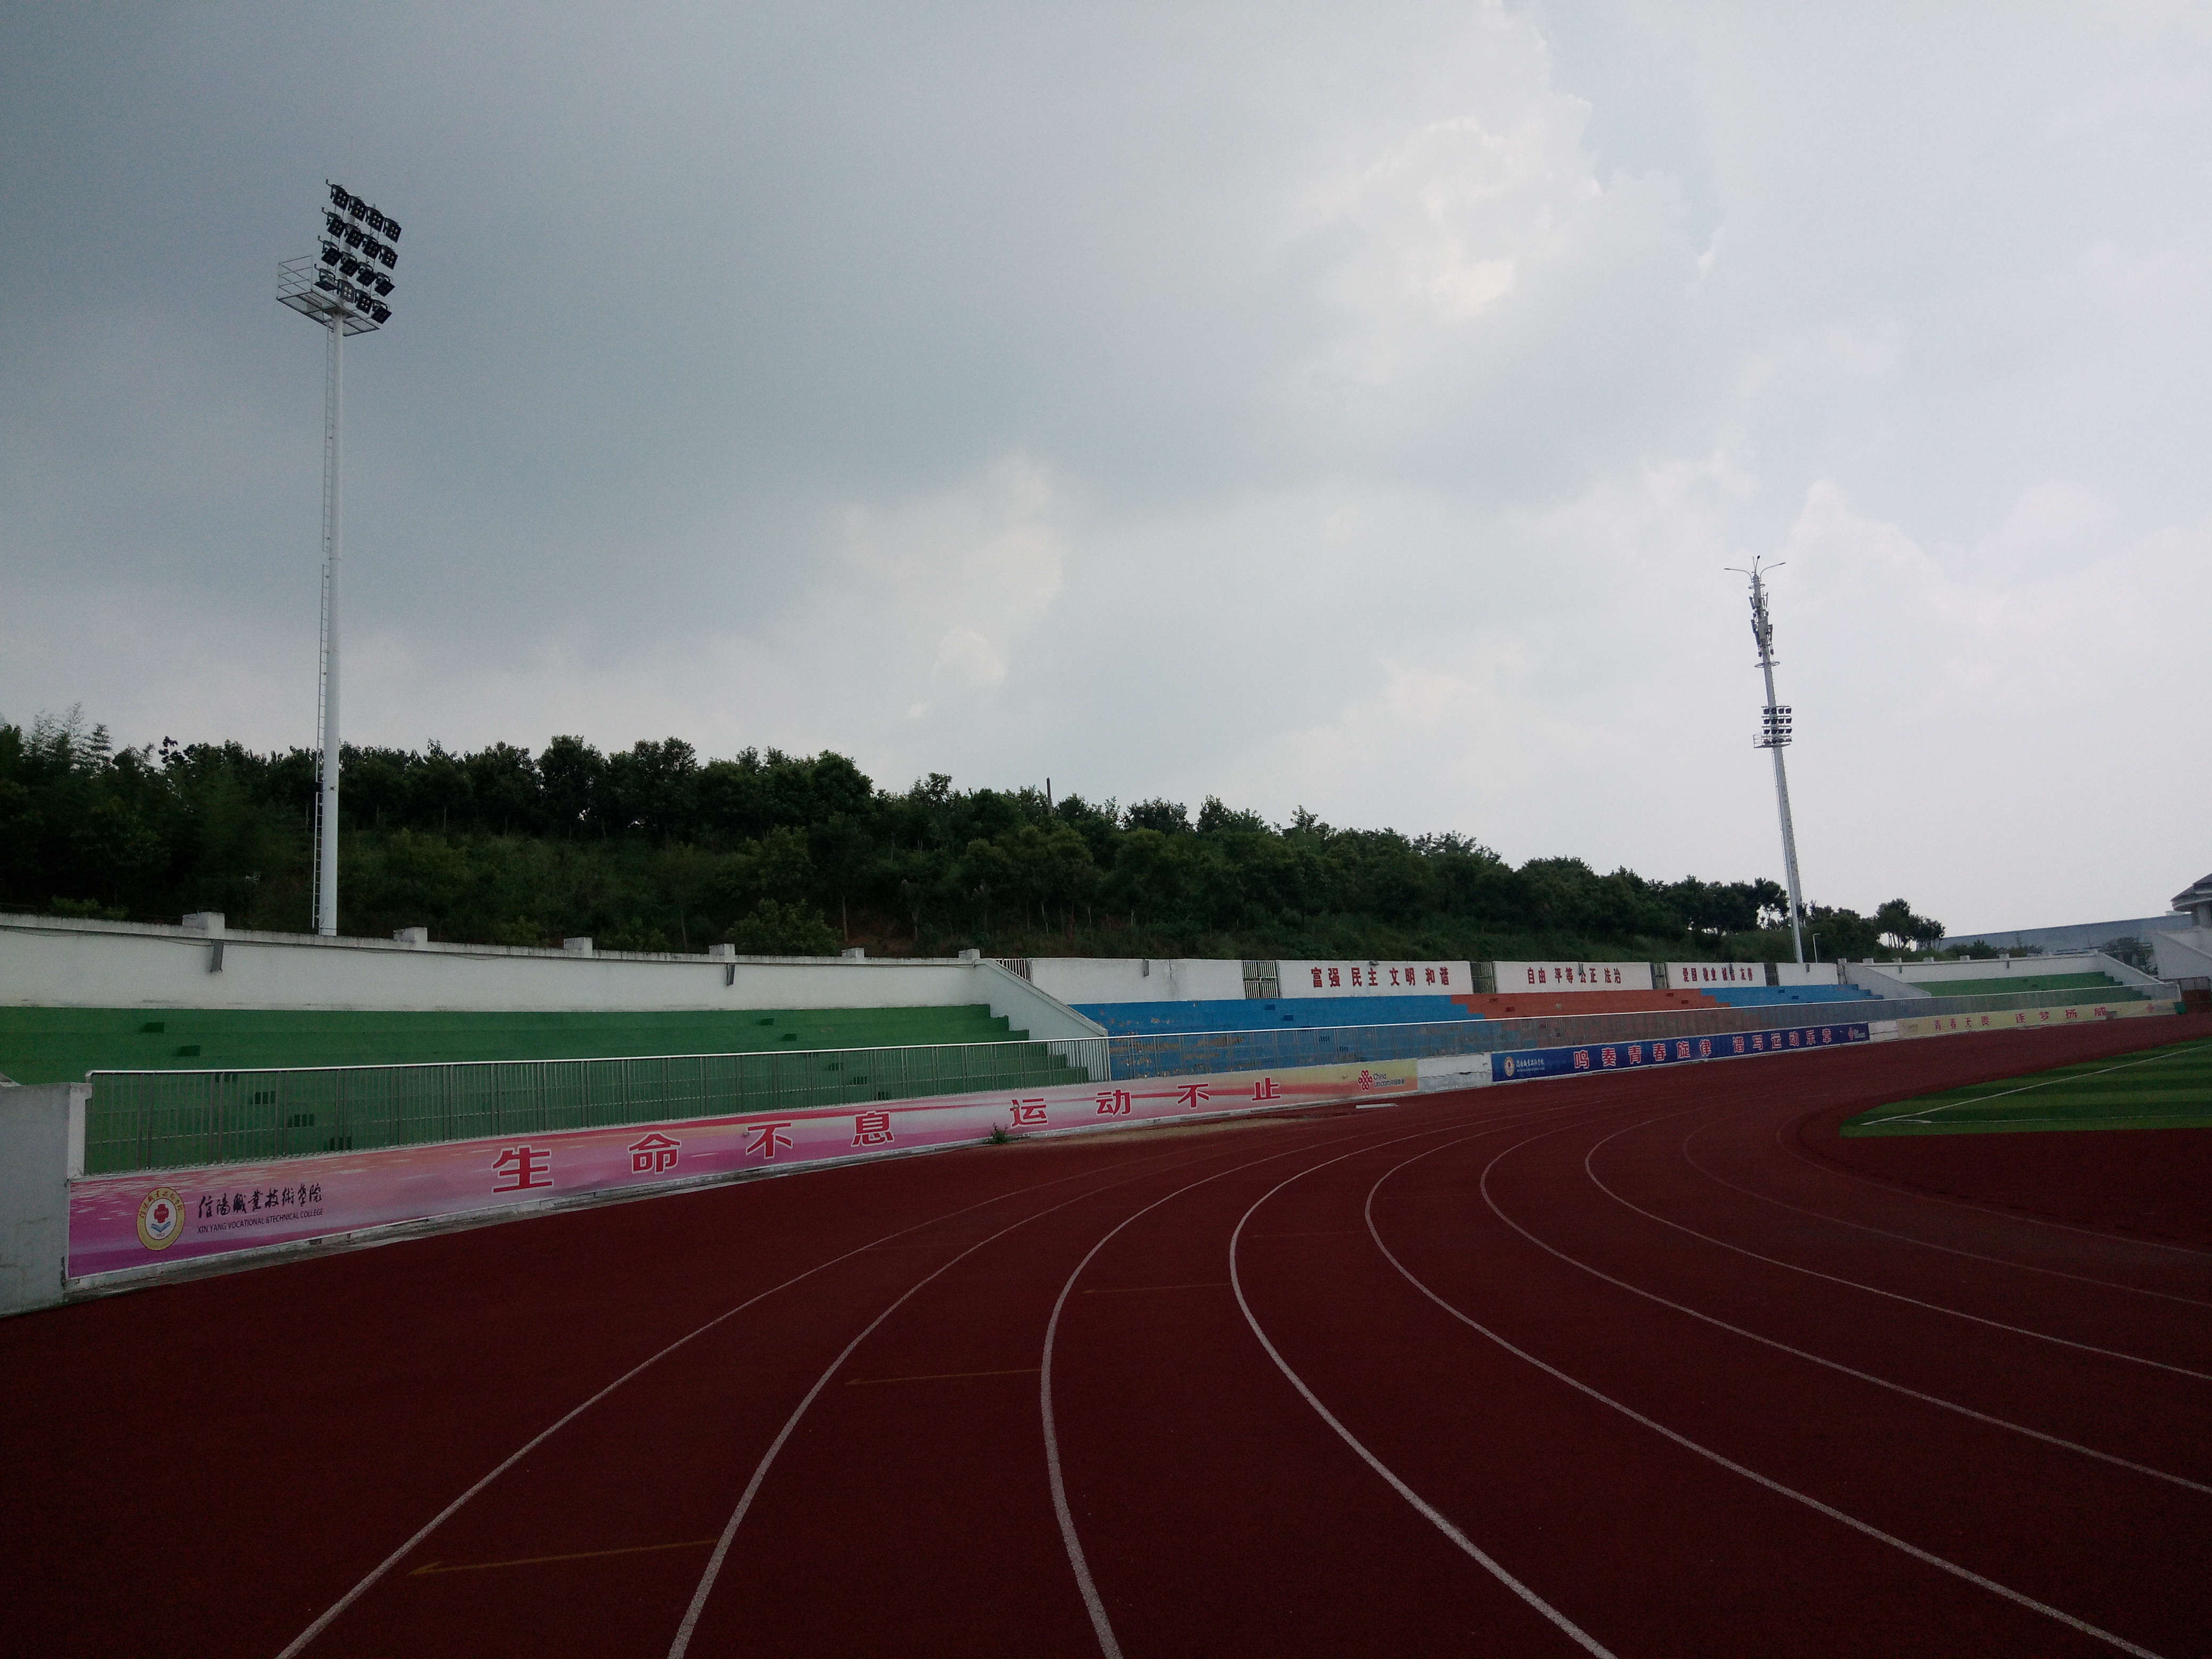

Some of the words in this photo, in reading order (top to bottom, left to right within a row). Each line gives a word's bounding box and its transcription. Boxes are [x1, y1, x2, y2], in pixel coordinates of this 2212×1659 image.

[1573, 1038, 1712, 1069] 鸣奏青春旋律
[1732, 1028, 1832, 1053] 谱写运动乐章
[492, 1110, 895, 1194] 生命不息
[1009, 1077, 1281, 1128] 运动不止
[197, 1225, 208, 1234] XIN
[210, 1222, 227, 1232] YANG
[228, 1217, 264, 1229] VOCATIONAL
[300, 1208, 323, 1218] COLLEGE
